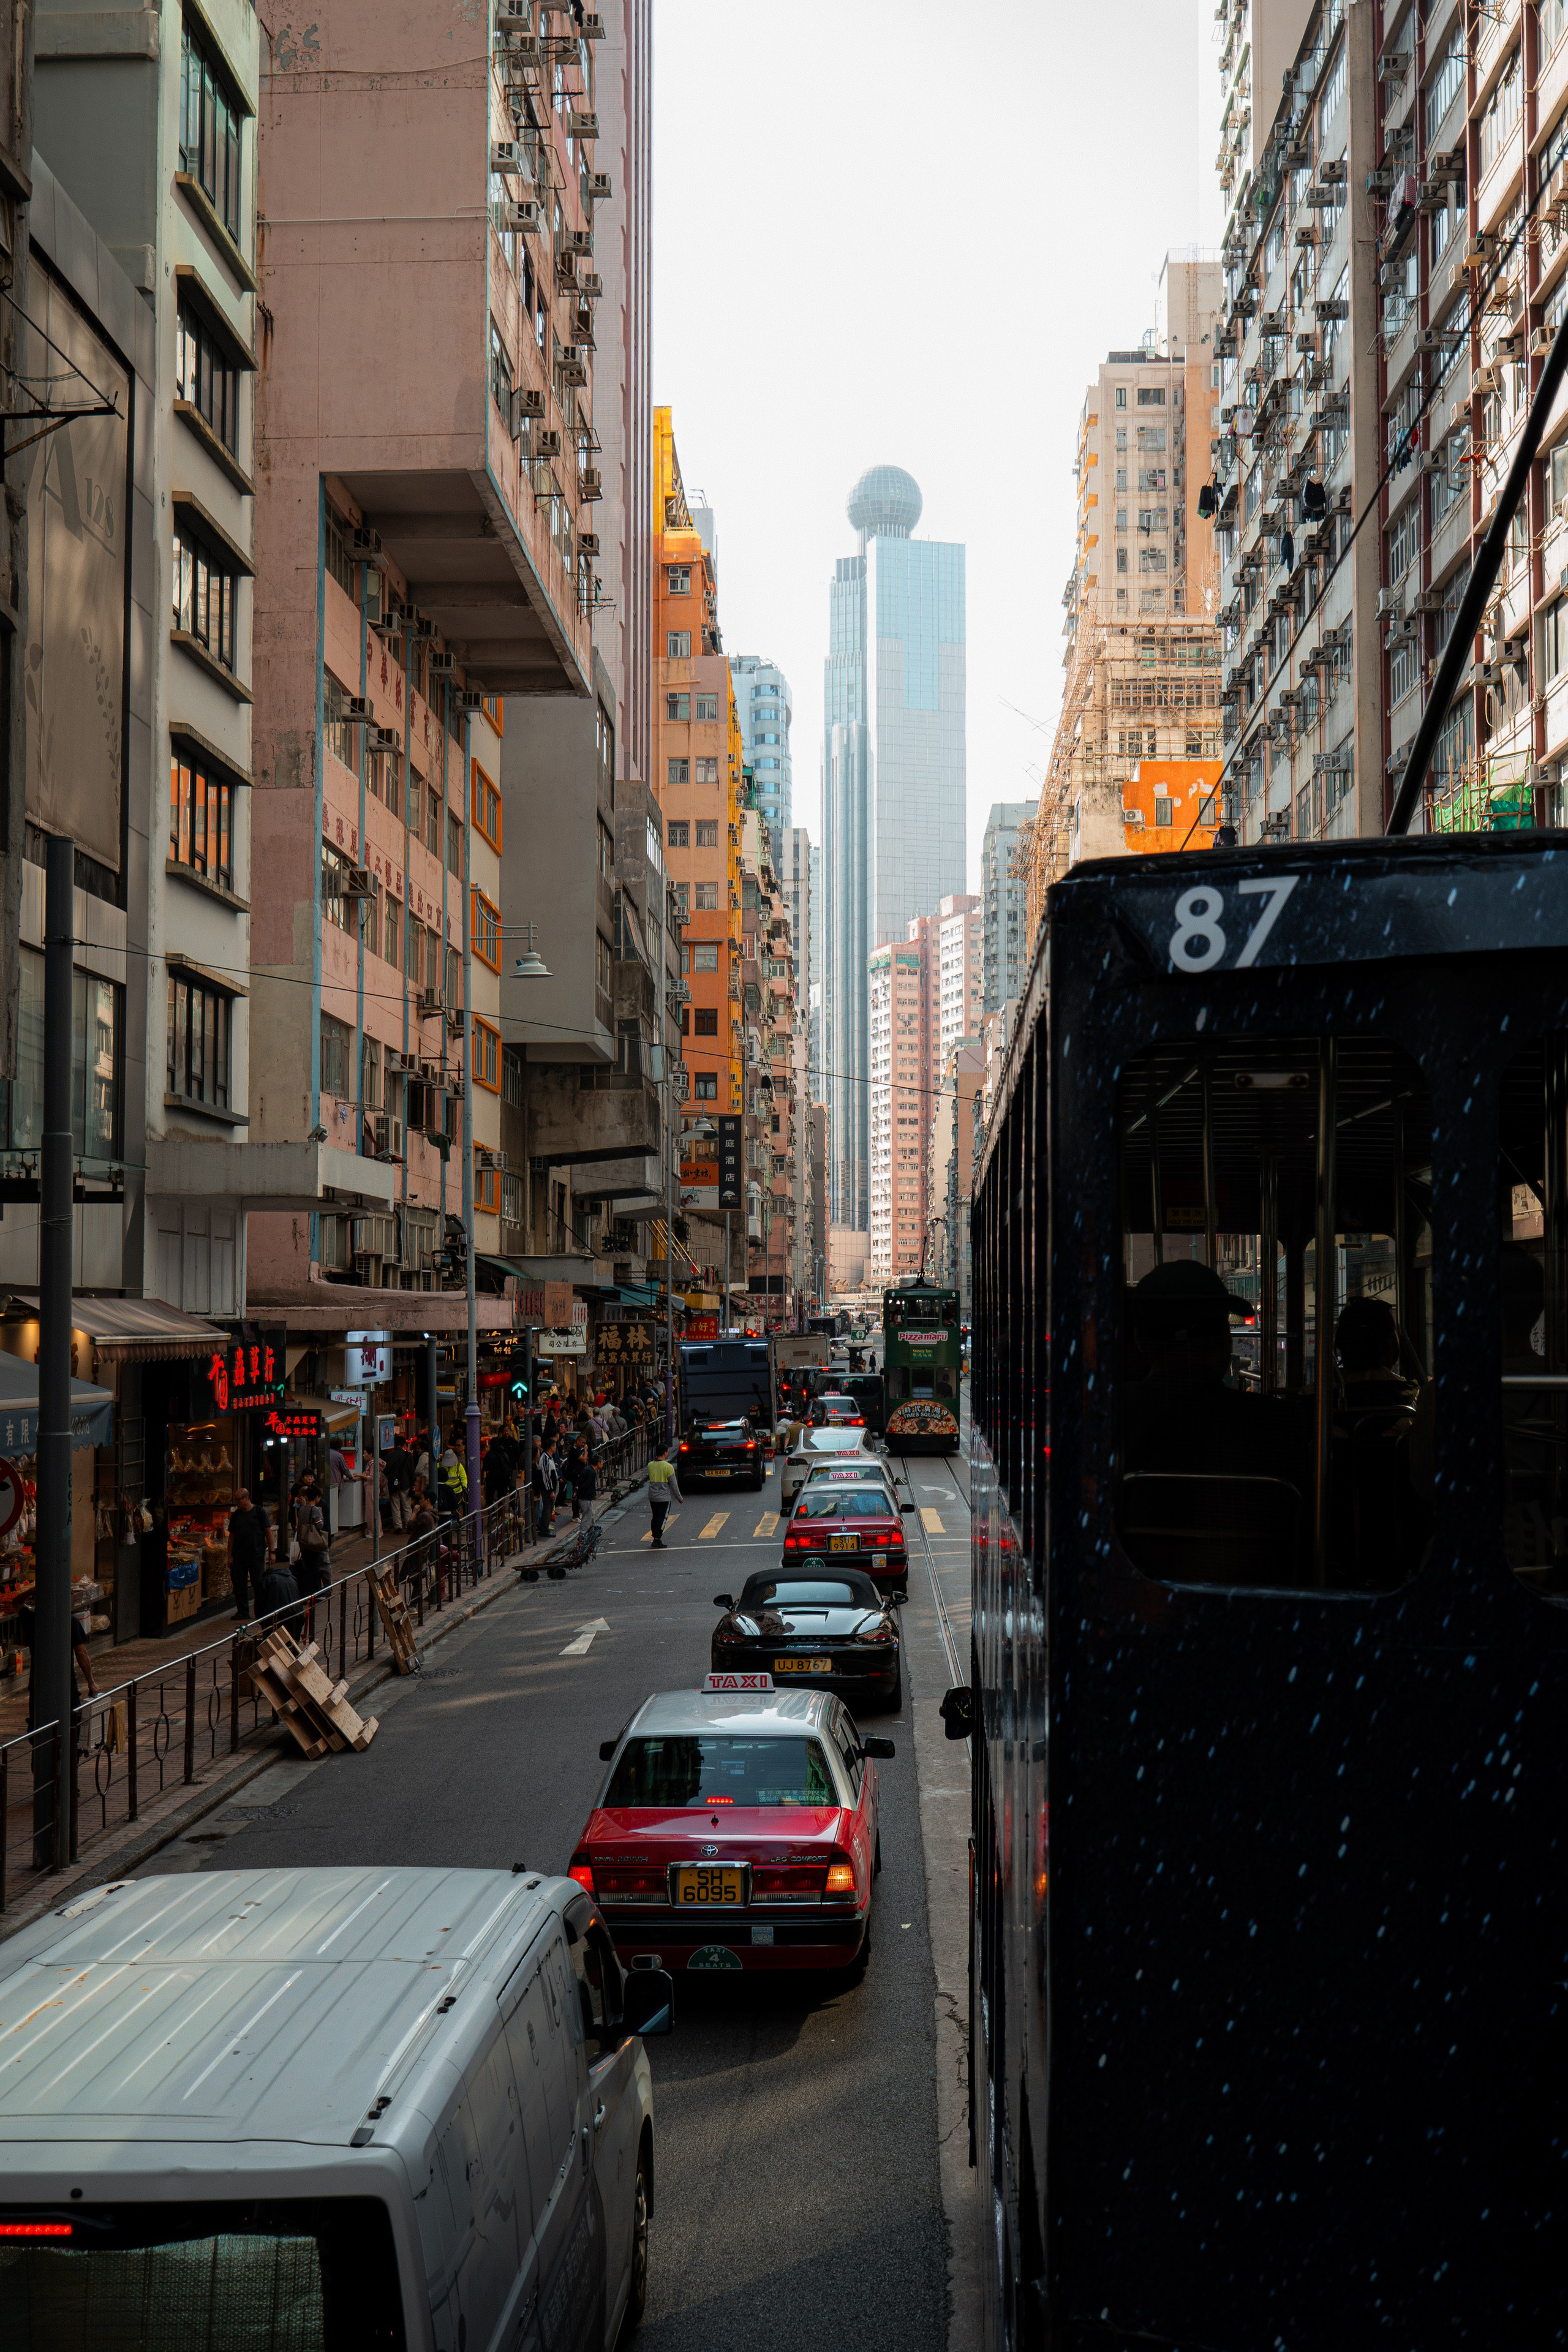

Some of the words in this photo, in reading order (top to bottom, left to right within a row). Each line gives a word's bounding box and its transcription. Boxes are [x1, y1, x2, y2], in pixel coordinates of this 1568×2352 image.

[85, 478, 115, 539] 128
[1169, 875, 1300, 974] 87
[725, 1122, 735, 1182] 頤庭酒店
[689, 1322, 709, 1332] 百好
[598, 1324, 652, 1350] 福林
[597, 1351, 652, 1364] 燕窩參茸行
[904, 1405, 941, 1414] 時代廣場
[285, 1416, 317, 1425] 冬蟲夏草
[778, 1660, 793, 1670] UJ
[797, 1660, 828, 1670] 8767
[709, 1675, 767, 1688] TAXI
[696, 1870, 723, 1885] SH
[684, 1886, 736, 1902] 6095
[709, 1953, 720, 1962] 4
